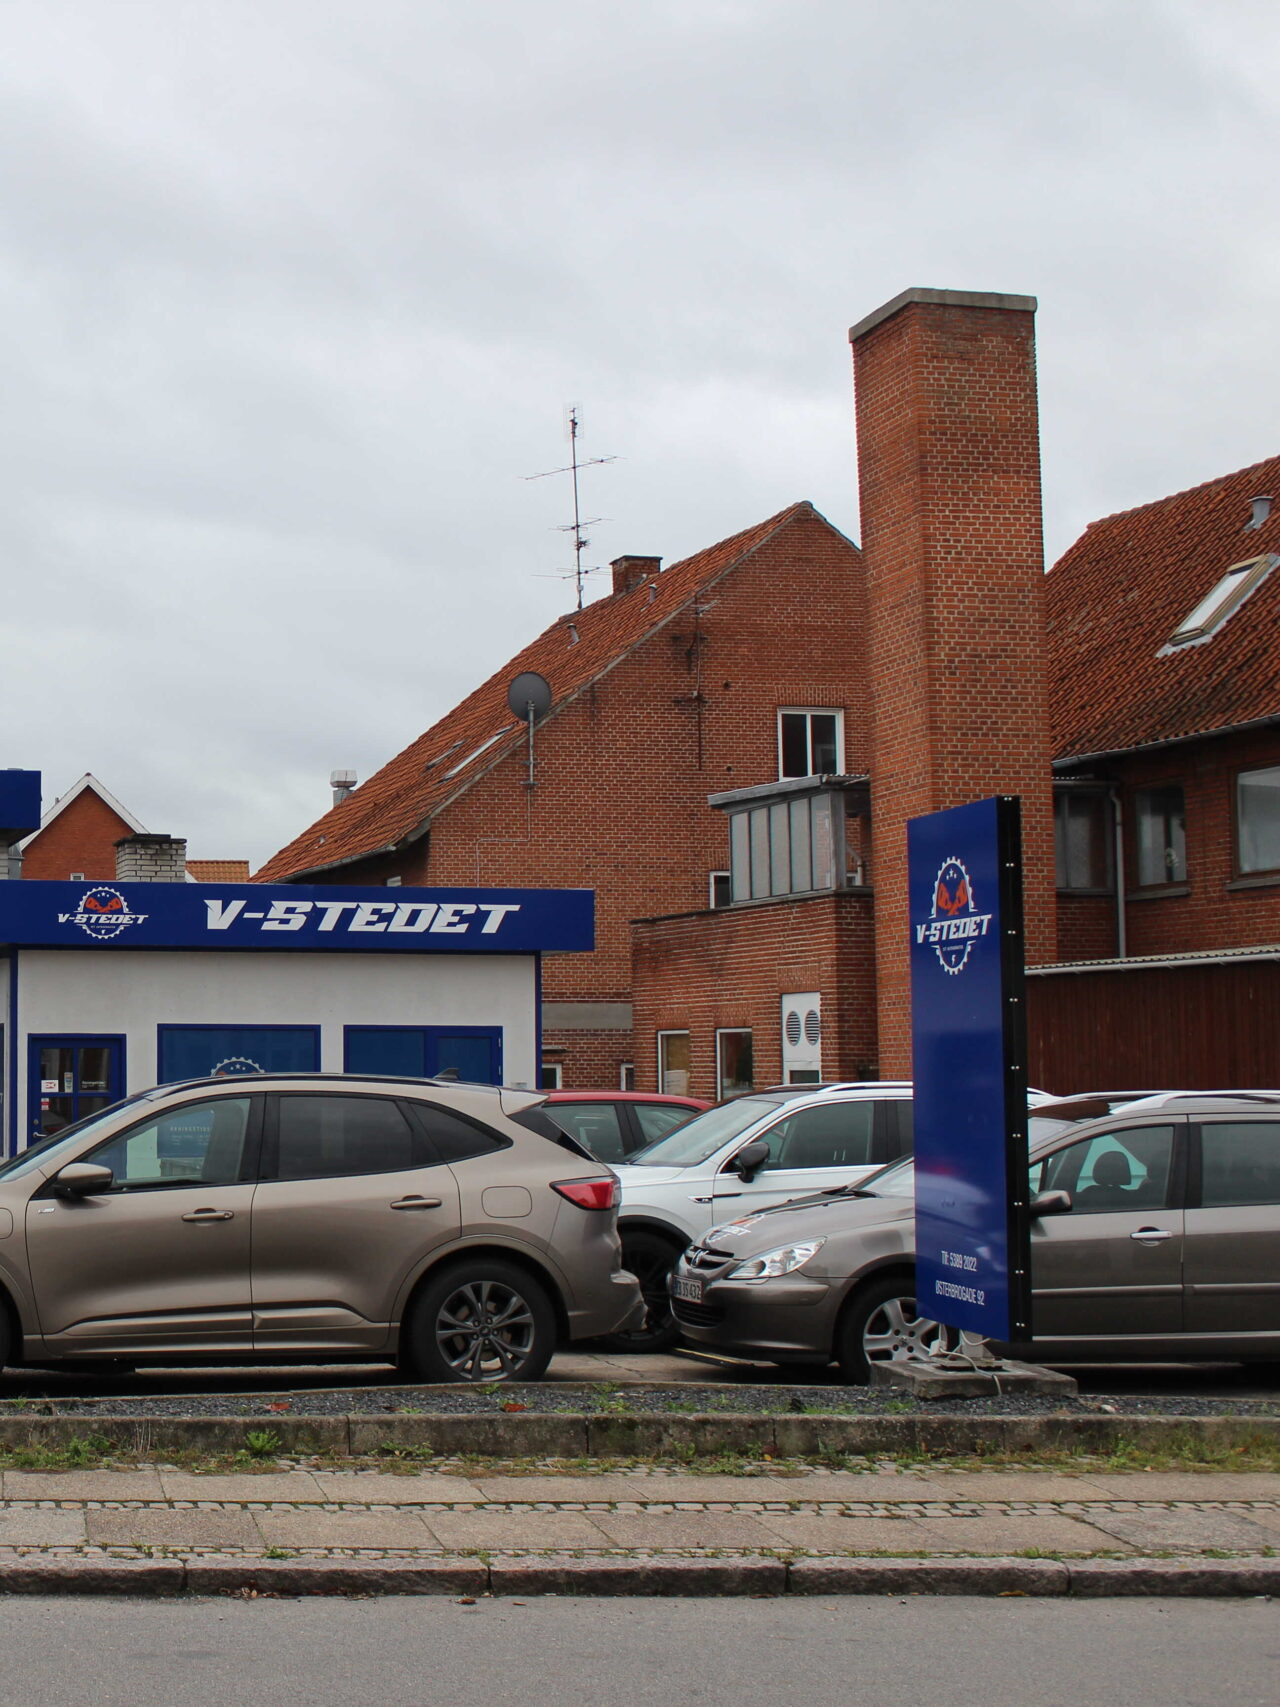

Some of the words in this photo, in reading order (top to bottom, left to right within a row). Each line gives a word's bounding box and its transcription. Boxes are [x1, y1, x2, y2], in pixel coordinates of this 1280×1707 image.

[57, 913, 149, 924] V-STEDET
[204, 899, 521, 934] V-STEDET
[916, 913, 993, 944] V-STEDET
